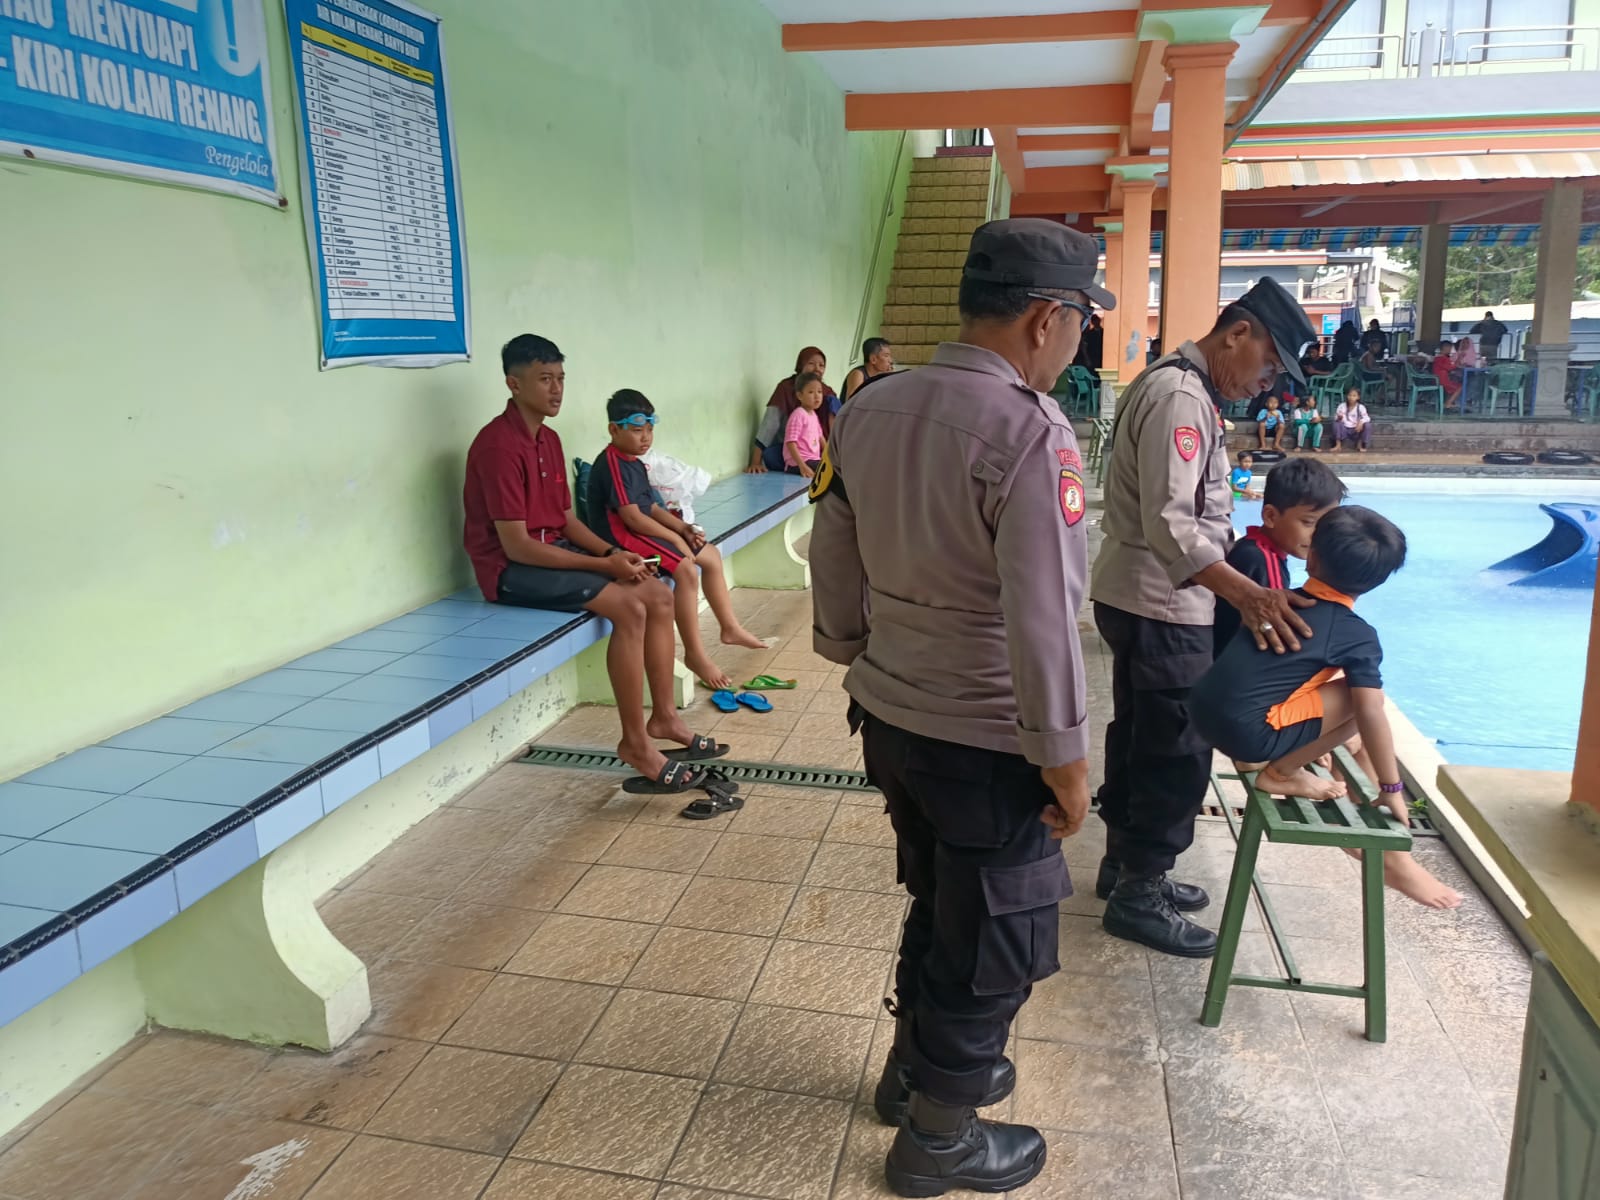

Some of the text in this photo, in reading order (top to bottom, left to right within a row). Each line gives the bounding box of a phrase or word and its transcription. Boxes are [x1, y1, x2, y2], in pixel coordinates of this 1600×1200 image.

[65, 0, 198, 71] MENYUAPI
[11, 34, 79, 100] KIRI
[80, 53, 175, 122] KOLAM
[175, 79, 264, 144] RENANG
[205, 146, 269, 177] Pengelola
